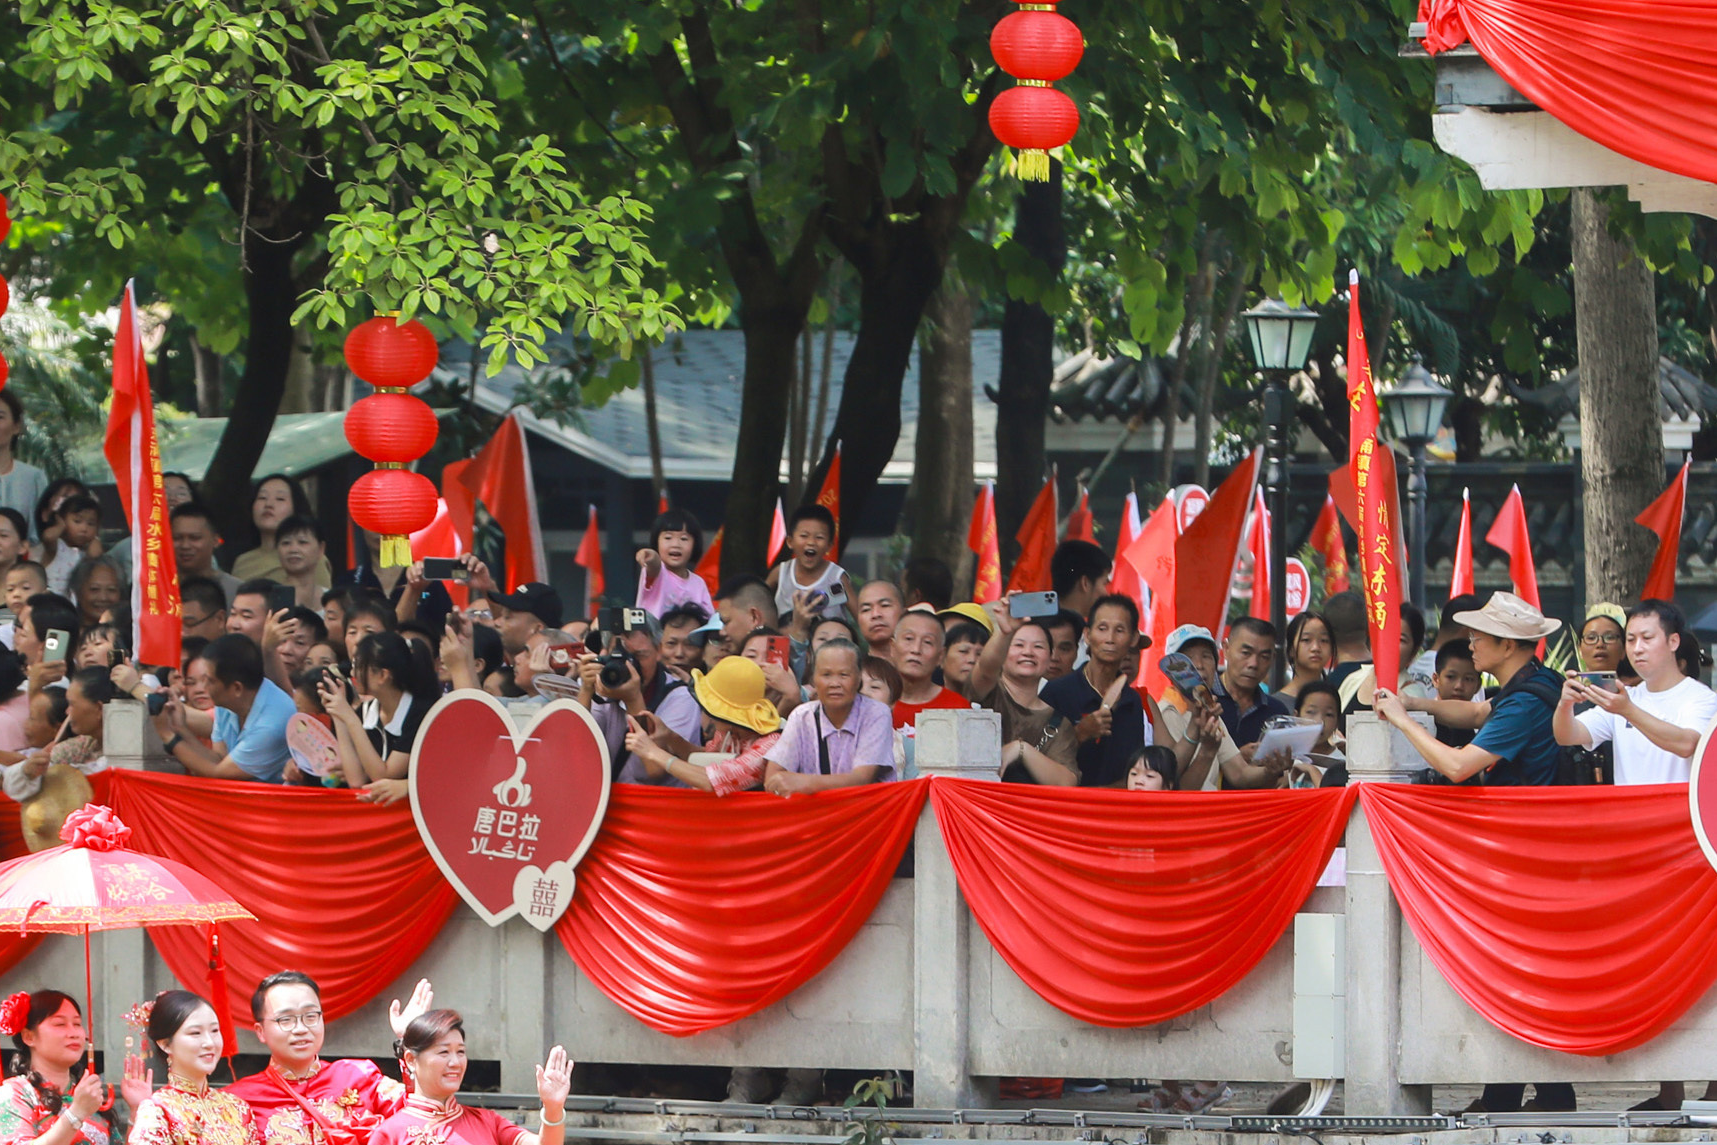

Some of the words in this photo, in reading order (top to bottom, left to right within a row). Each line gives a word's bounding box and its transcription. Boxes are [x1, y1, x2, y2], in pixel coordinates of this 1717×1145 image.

[473, 806, 541, 841] 唐巴拉
[529, 877, 560, 918] 囍
